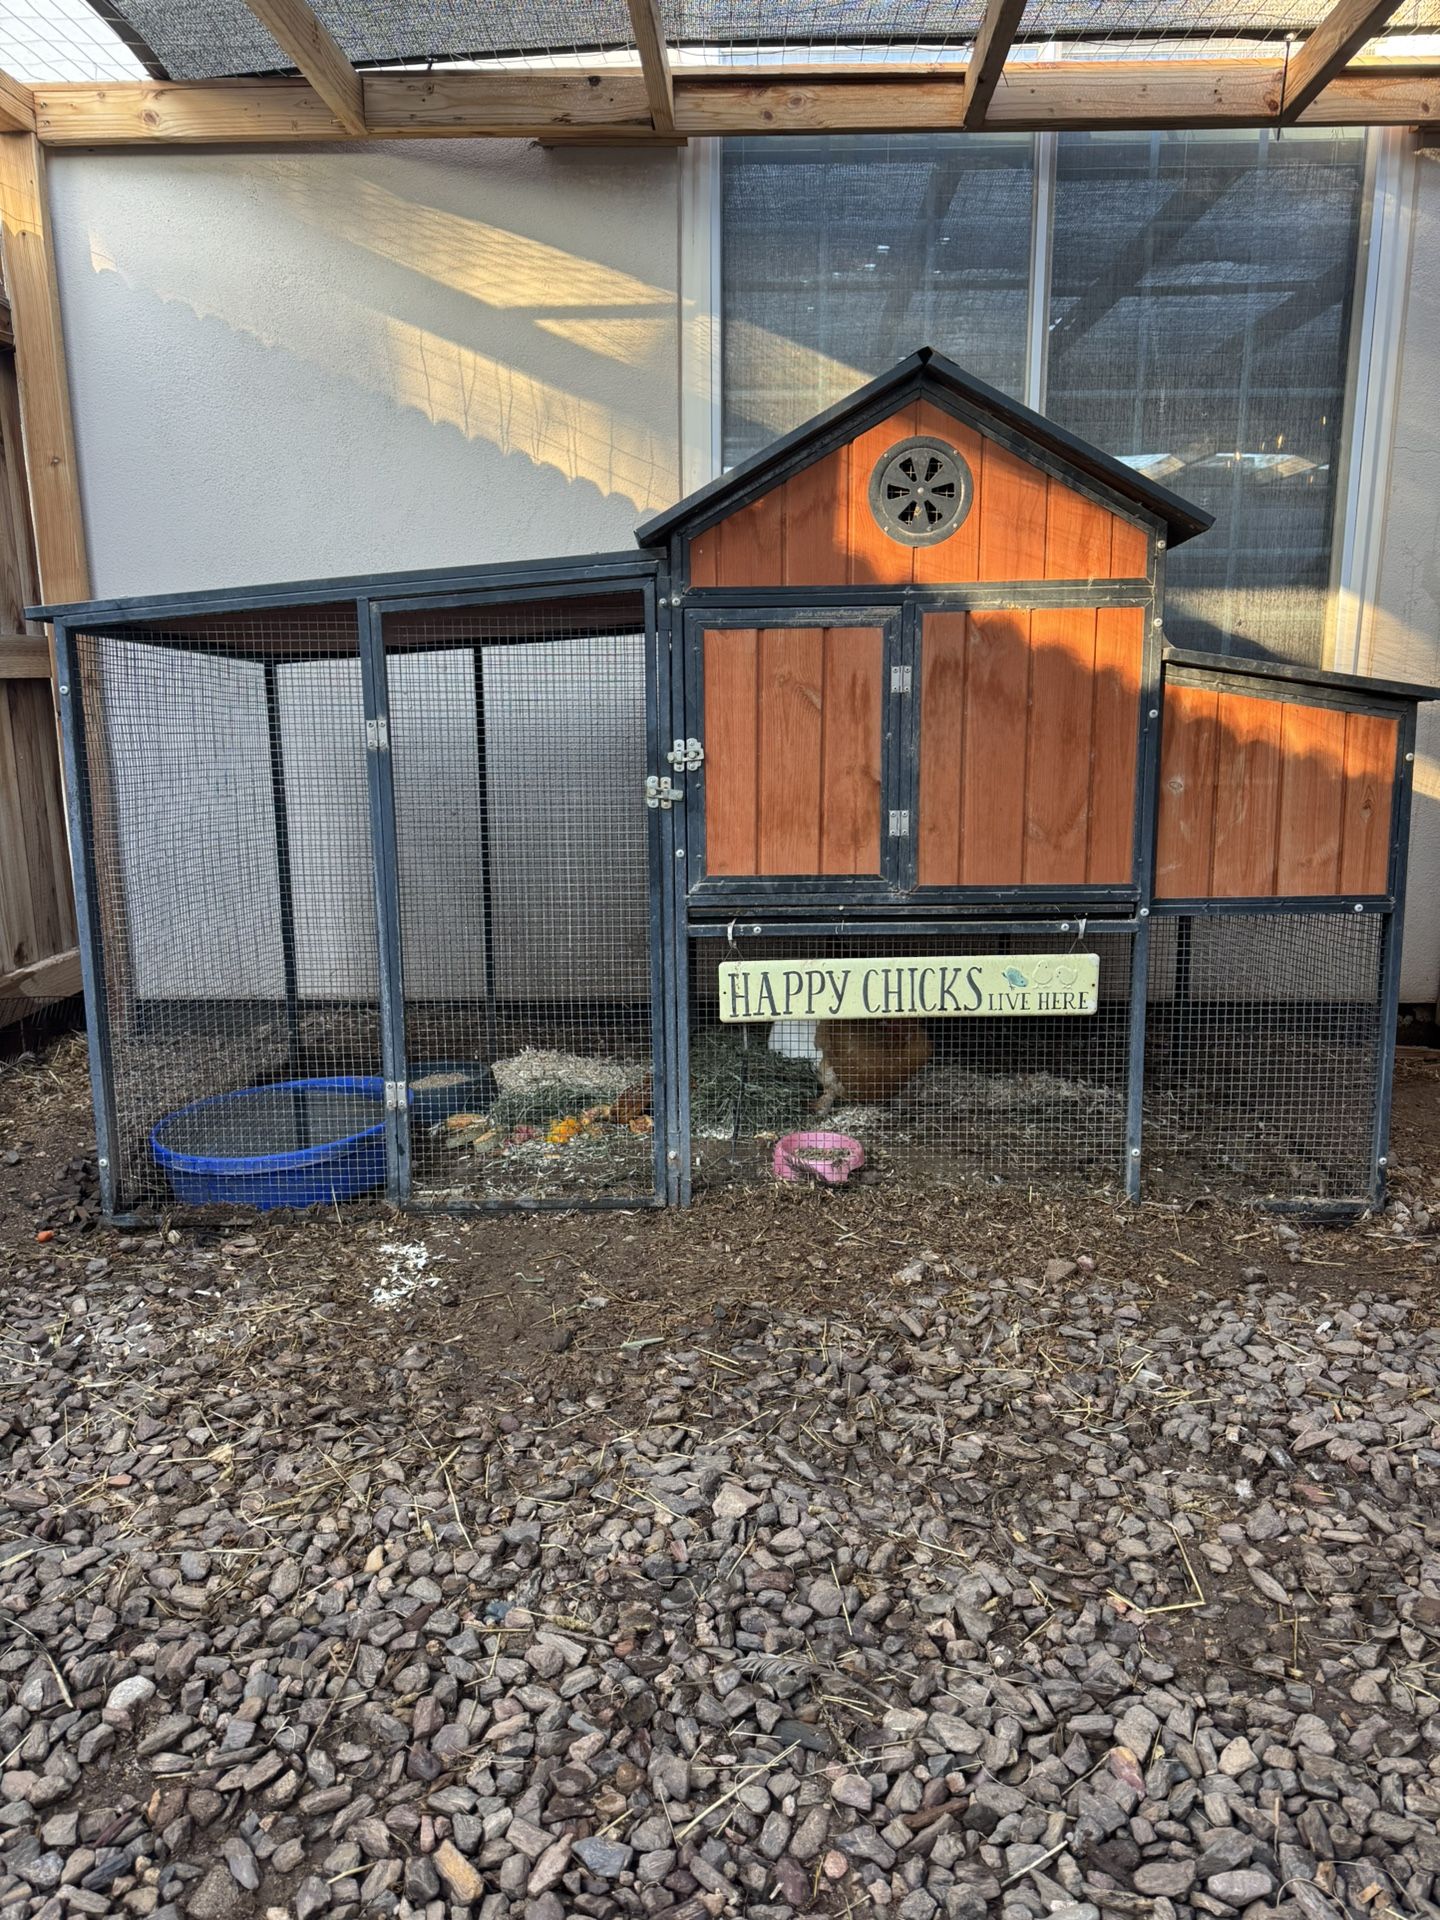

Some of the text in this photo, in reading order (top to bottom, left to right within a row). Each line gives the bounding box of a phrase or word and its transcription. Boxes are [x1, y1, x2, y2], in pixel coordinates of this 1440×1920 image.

[728, 967, 1089, 1018] HAPPY CHICKS LIVE HERE
